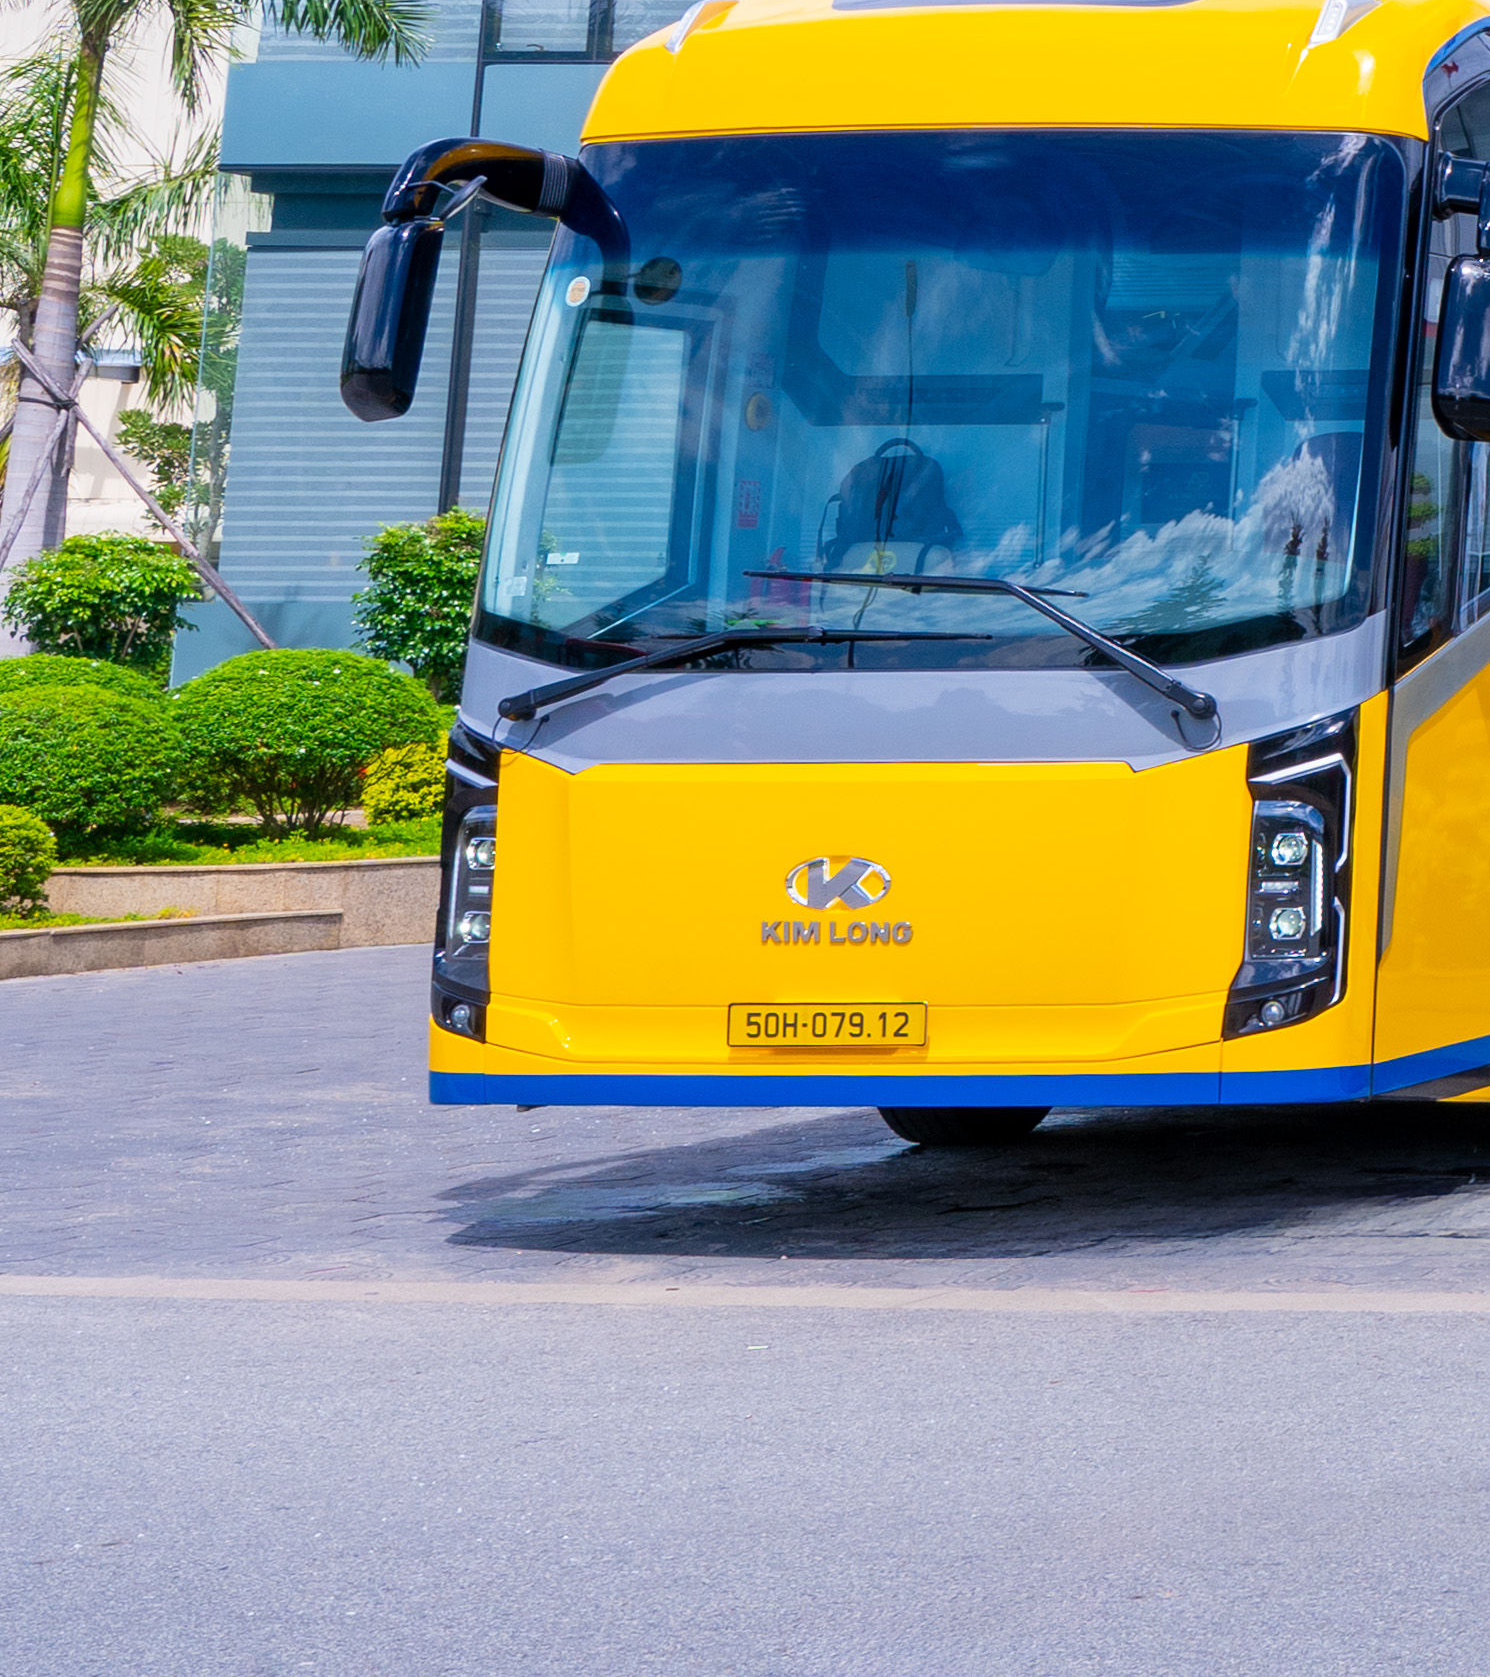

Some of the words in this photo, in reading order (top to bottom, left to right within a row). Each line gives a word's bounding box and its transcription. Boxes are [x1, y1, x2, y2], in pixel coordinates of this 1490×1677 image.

[761, 921, 820, 943] KIM
[830, 921, 912, 943] LONG
[746, 1011, 909, 1038] 50H-079.12
